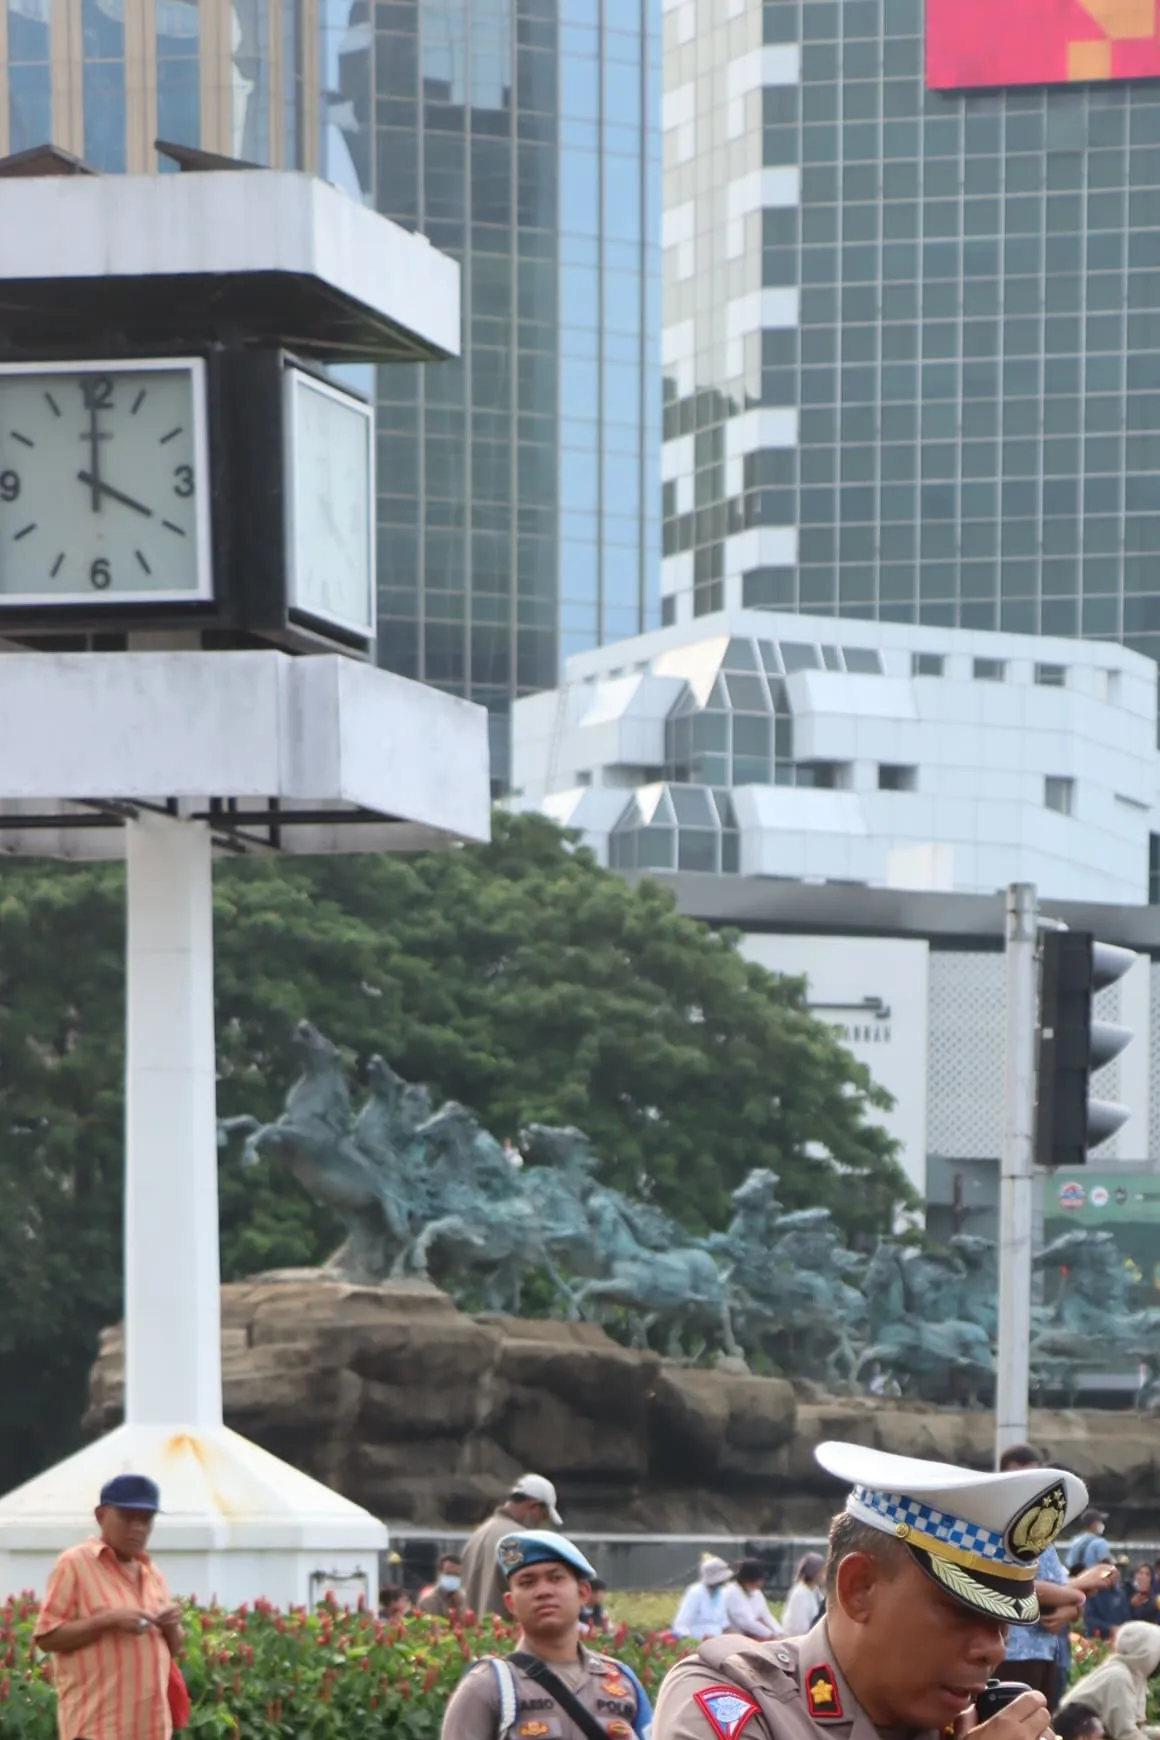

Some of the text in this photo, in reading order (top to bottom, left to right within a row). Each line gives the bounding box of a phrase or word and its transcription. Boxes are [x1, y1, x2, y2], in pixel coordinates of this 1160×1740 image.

[0, 469, 21, 502] 9
[172, 464, 196, 498] 3
[90, 557, 112, 590] 6
